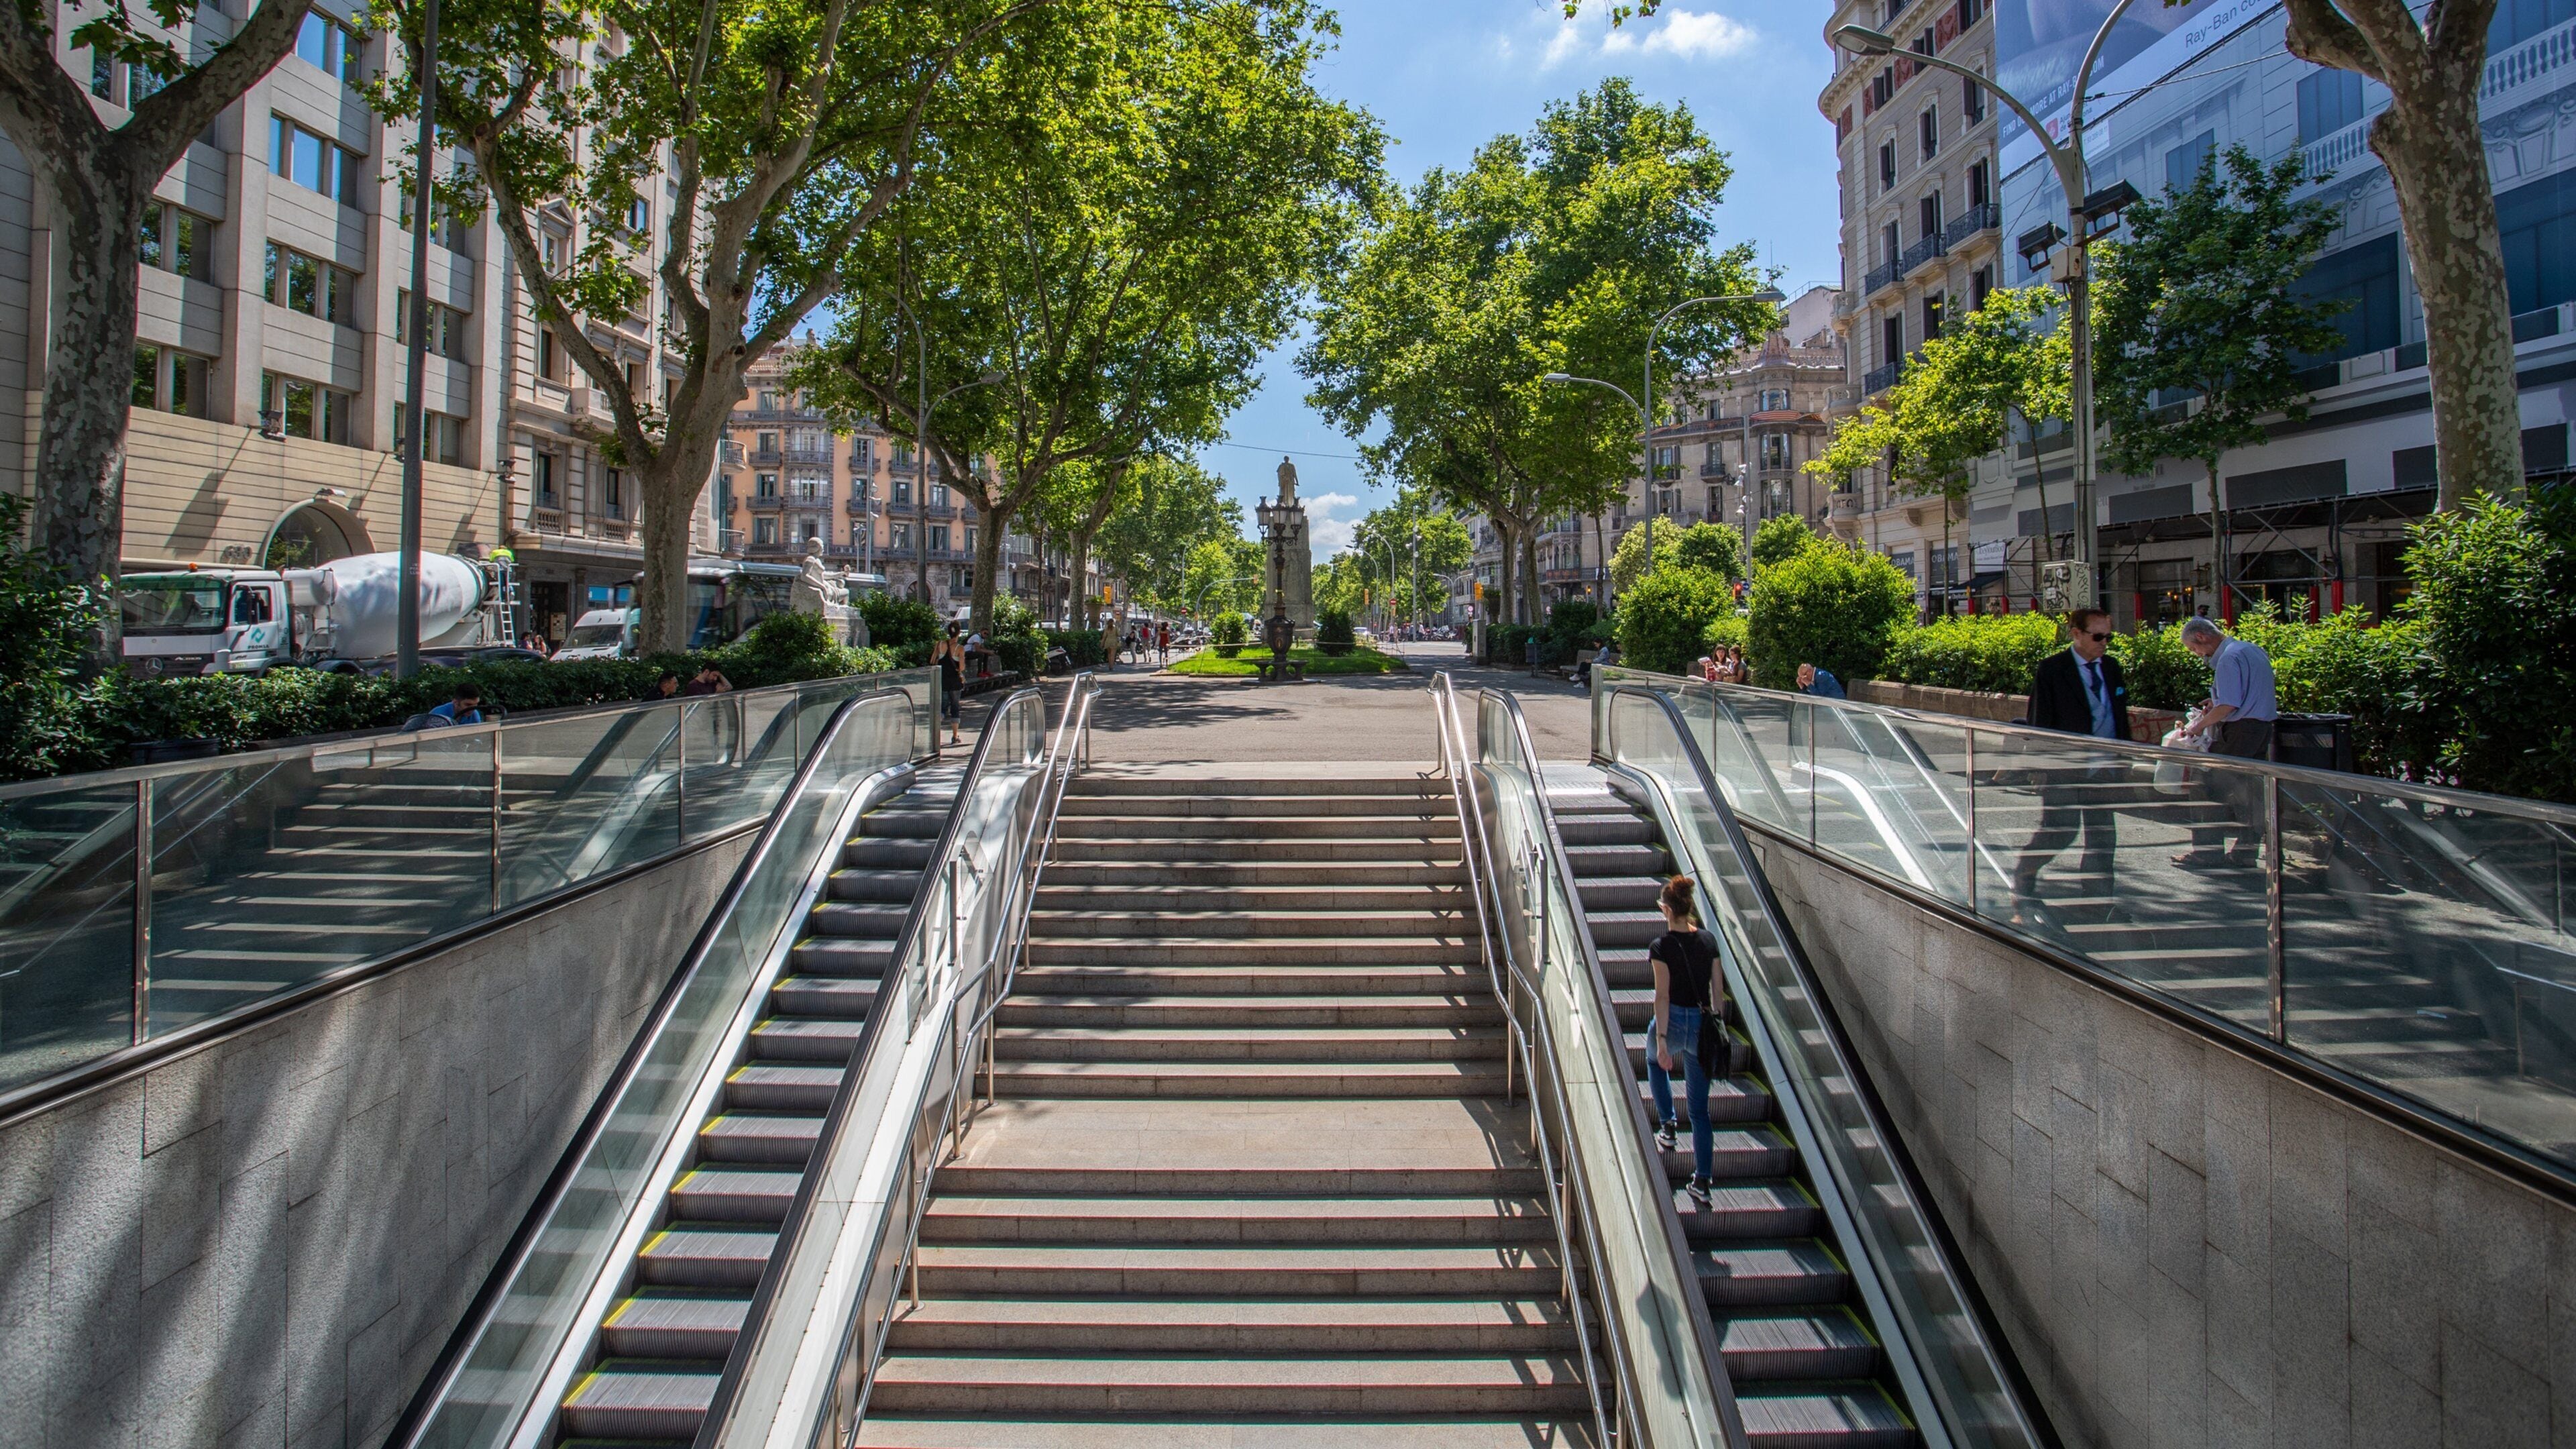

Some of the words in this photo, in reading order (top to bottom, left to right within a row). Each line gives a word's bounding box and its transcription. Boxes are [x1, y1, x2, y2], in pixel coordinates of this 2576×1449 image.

[2186, 7, 2237, 48] Ray-Ban
[2002, 119, 2016, 138] FIND
[2030, 96, 2048, 115] MORE
[2049, 90, 2057, 105] AT
